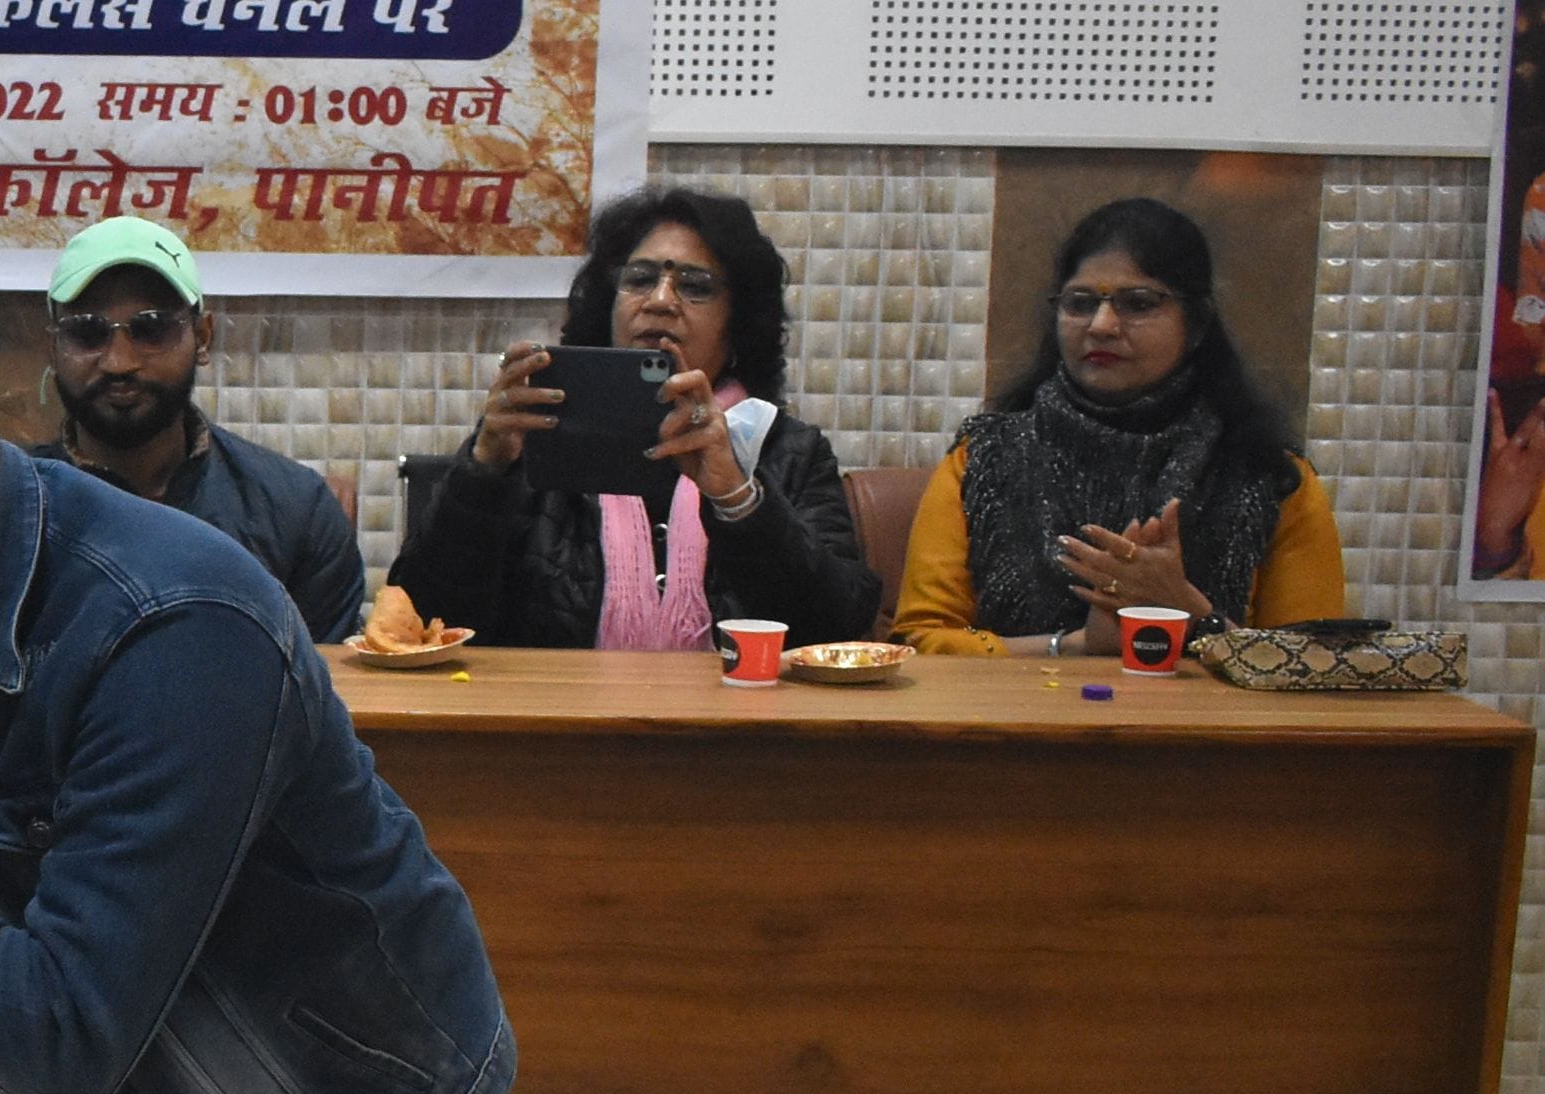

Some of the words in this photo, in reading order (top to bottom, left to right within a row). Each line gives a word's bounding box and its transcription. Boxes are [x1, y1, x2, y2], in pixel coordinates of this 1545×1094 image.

[97, 82, 223, 122] समय
[264, 84, 407, 126] 01:00
[425, 75, 512, 126] बजे
[255, 152, 528, 225] पानीपत
